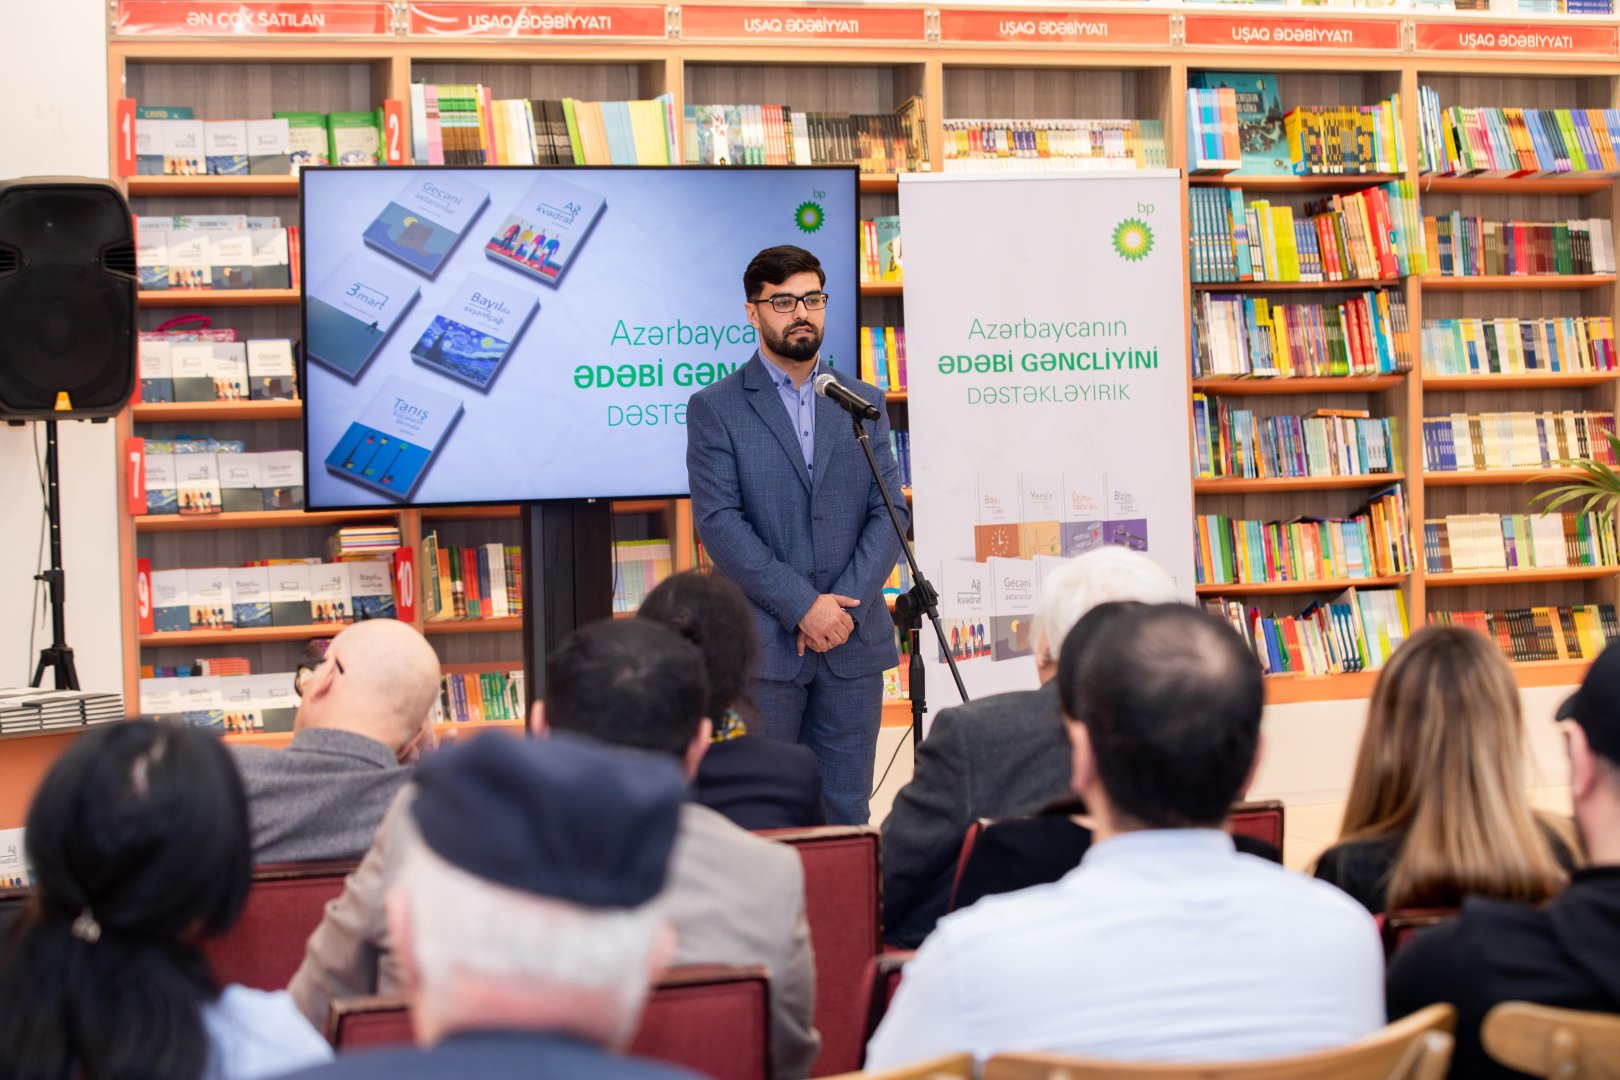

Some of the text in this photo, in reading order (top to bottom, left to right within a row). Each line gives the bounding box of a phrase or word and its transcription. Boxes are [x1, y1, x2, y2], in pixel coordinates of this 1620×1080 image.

[186, 12, 213, 26] ƏN
[258, 12, 325, 27] SATILAN
[519, 13, 611, 29] ƏDƏBİYYATI
[744, 17, 859, 33] UŞAQ ƏDƏBİYYATI
[1000, 20, 1107, 36] UŞAQ ƏDƏBİYYATI
[1232, 27, 1352, 43] UŞAQ ƏDƏBİYYATI
[1459, 33, 1572, 48] UŞAQ ƏDƏBİYYATI
[122, 113, 131, 160] 1
[389, 113, 400, 160] 2
[813, 189, 825, 199] bp
[1137, 201, 1155, 216] bp
[610, 319, 756, 350] Azərbayca
[968, 318, 1127, 343] Azərbaycanın
[938, 347, 1158, 374] ƏDƏBİ GƏNCLİYİNİ
[574, 359, 663, 388] ƏDƏBİ
[967, 383, 1131, 405] DƏSTƏKLƏYİRİK
[130, 452, 141, 499] 7
[138, 572, 149, 618] 9
[398, 561, 413, 607] 10
